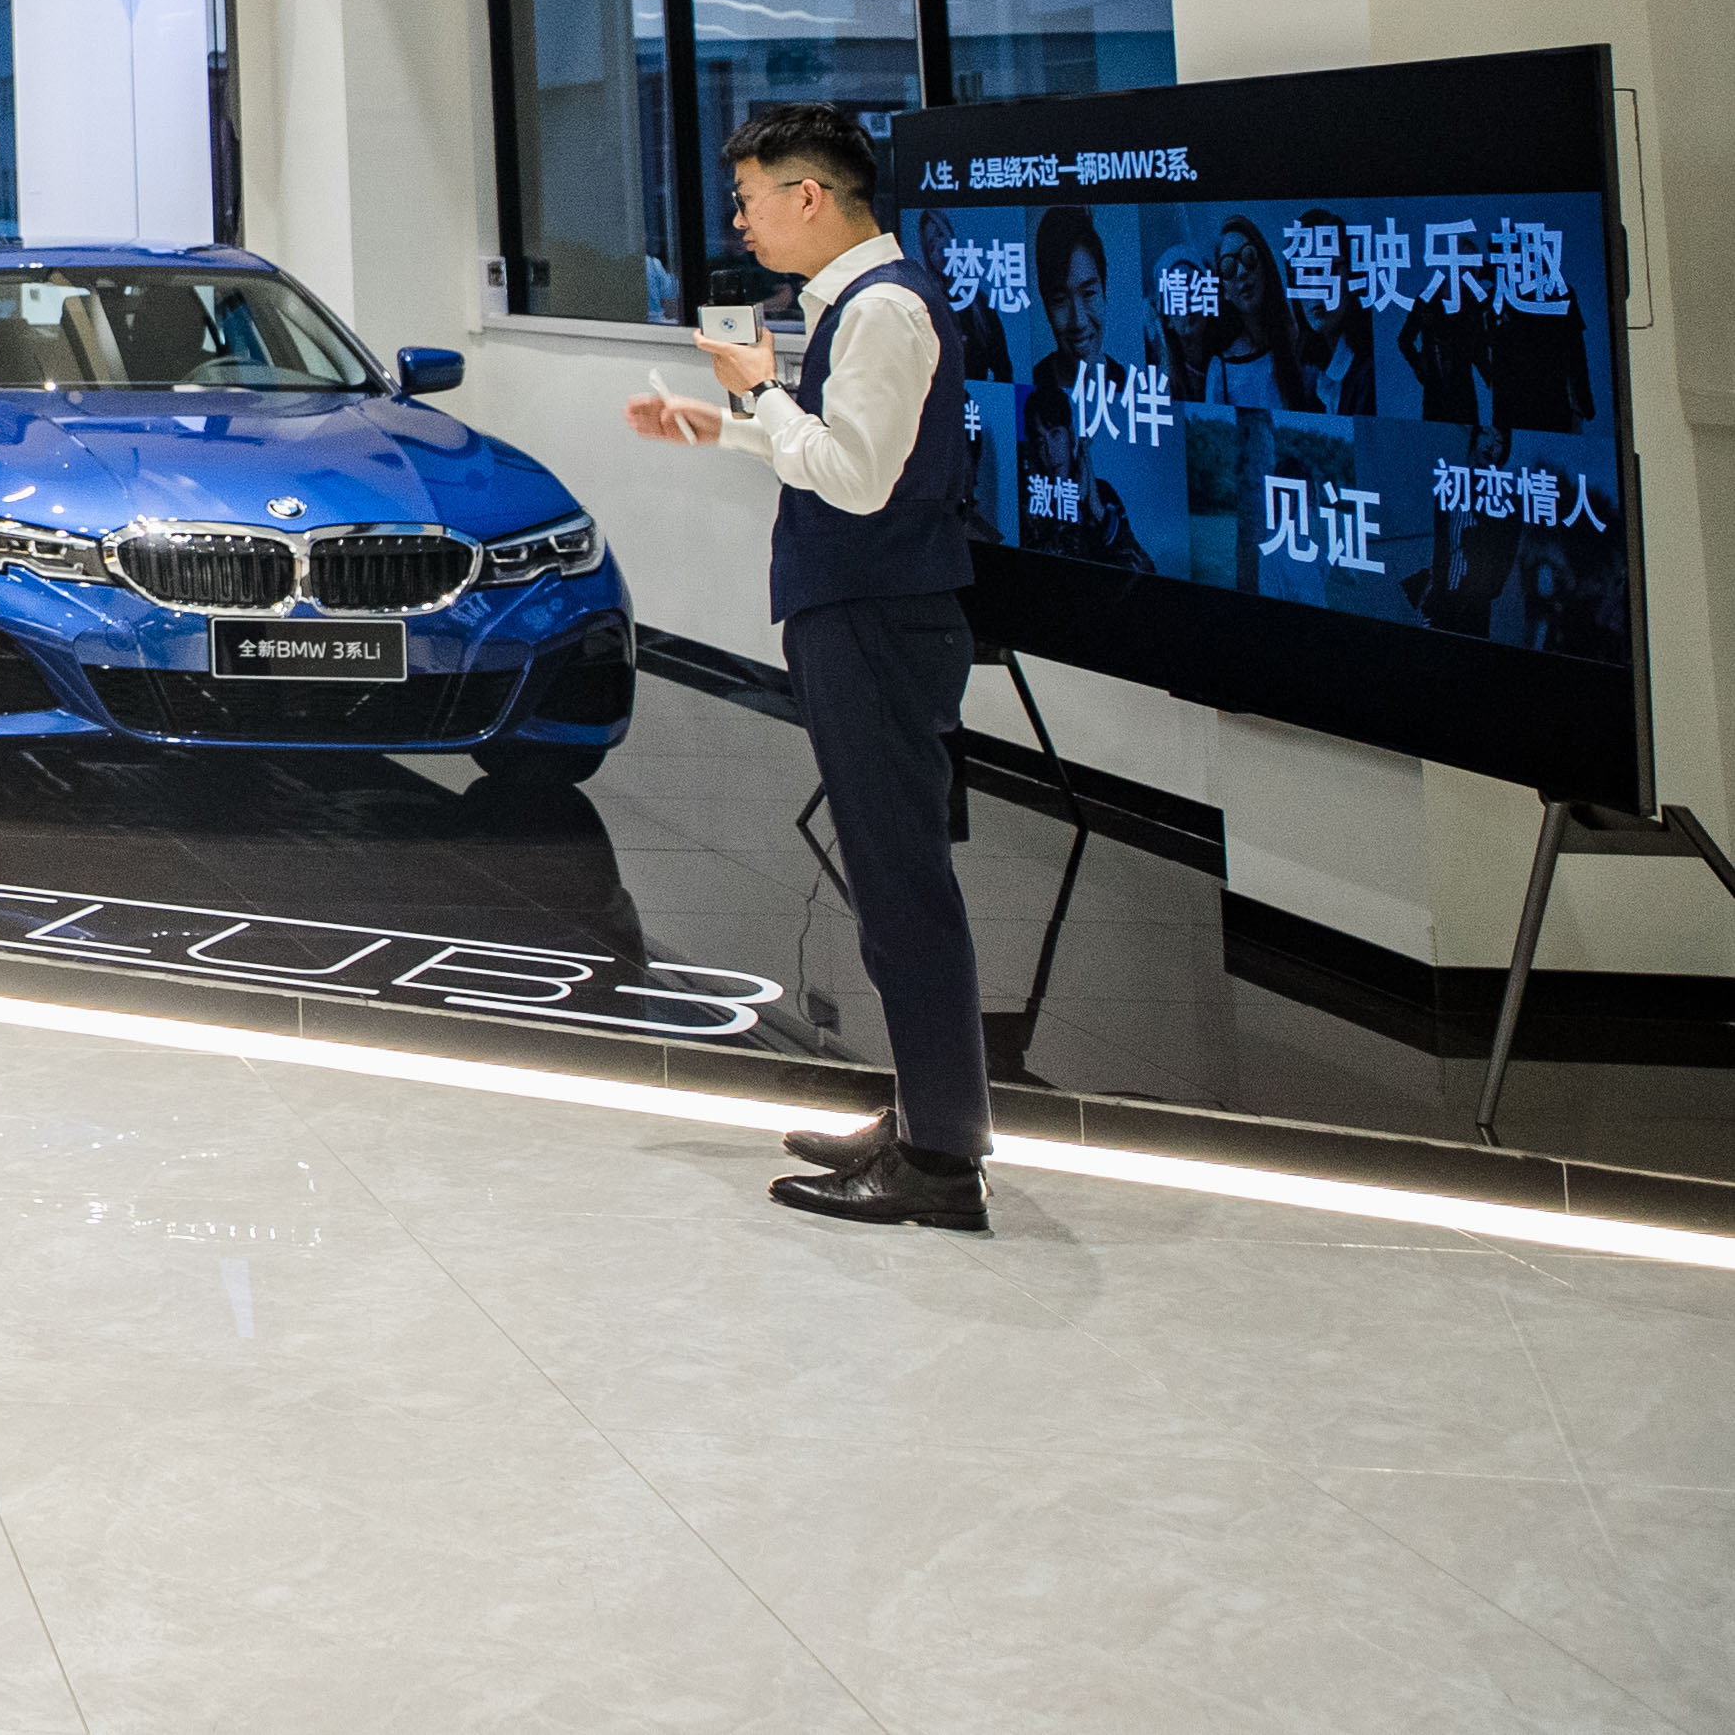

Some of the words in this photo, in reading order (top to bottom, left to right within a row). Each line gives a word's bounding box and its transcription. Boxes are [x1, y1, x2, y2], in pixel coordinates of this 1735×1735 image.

[943, 239, 1032, 314] 梦想
[1159, 268, 1221, 319] 情结
[1282, 216, 1572, 316] 驾驶乐趣
[1072, 359, 1175, 448] 伙伴
[1026, 473, 1082, 525] 激情
[1259, 474, 1387, 576] 见证
[1433, 457, 1608, 534] 初恋情人
[238, 639, 326, 658] 全新BMW
[333, 641, 381, 660] 3系Li
